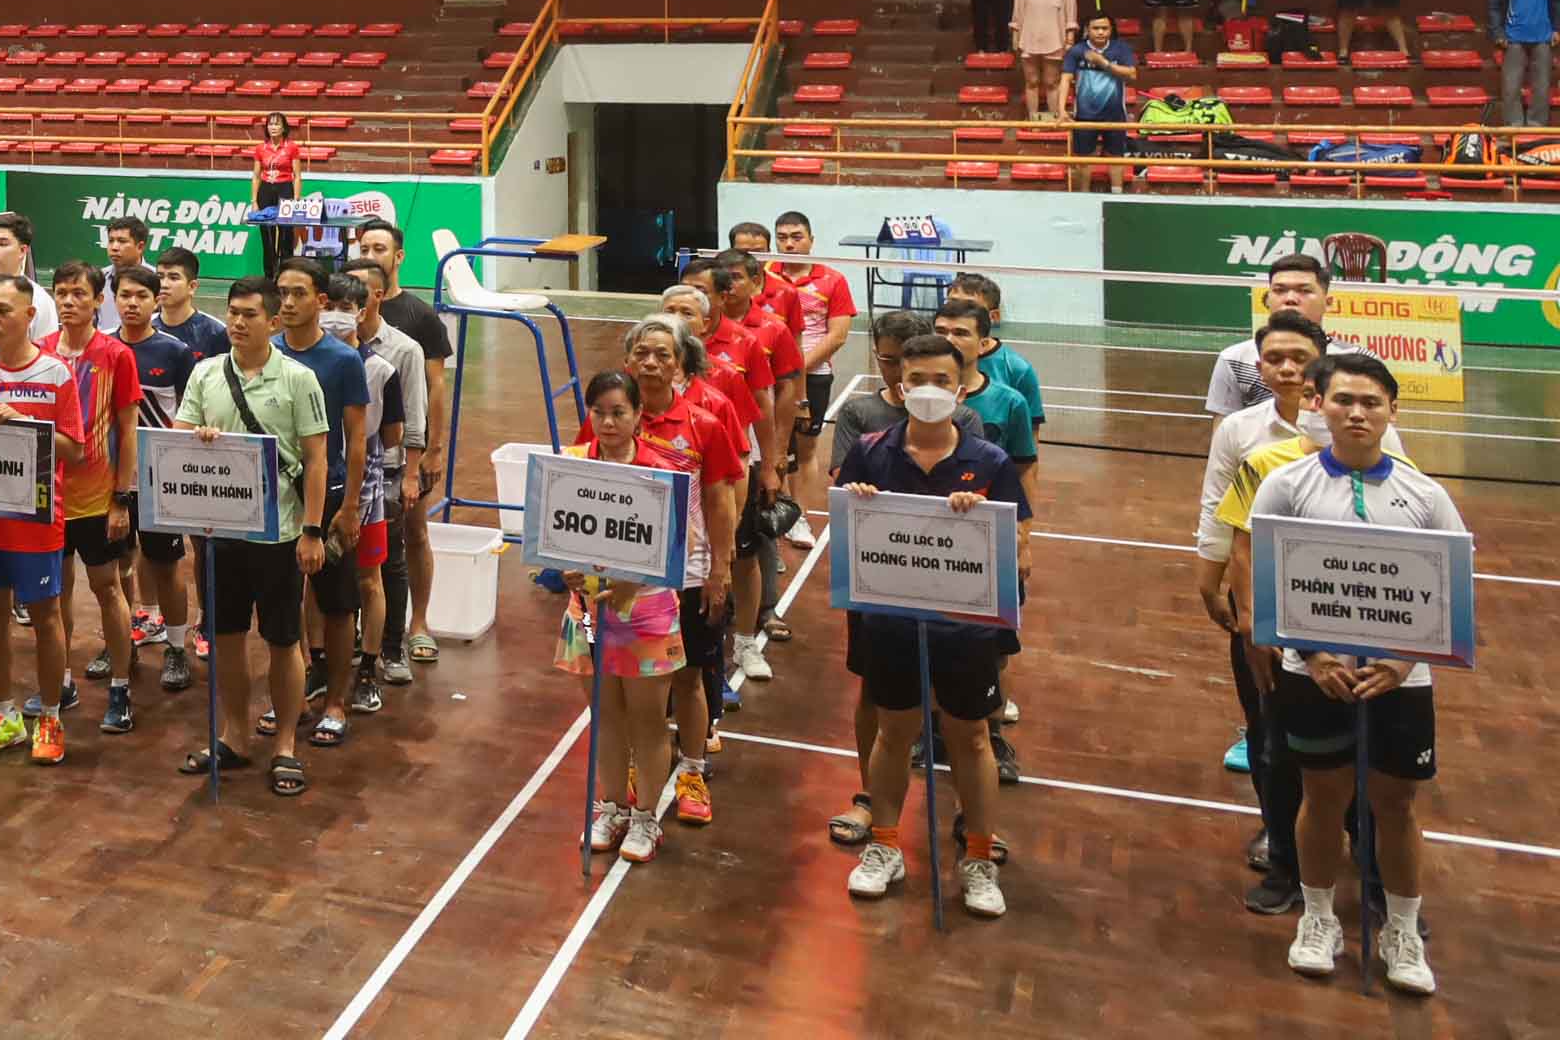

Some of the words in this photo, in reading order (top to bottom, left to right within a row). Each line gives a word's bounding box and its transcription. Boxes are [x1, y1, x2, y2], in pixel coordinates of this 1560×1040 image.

[78, 192, 169, 222] NĂNG
[1376, 234, 1536, 277] ĐỘNG
[9, 386, 48, 399] YONEX
[162, 482, 178, 495] SH
[181, 480, 209, 498] DIÊN
[211, 481, 253, 501] KHÁNH
[552, 510, 598, 536] SAO
[605, 512, 654, 545] BIỂN
[912, 555, 940, 570] HOA
[1291, 577, 1335, 595] PHÂN
[1340, 581, 1377, 601] VIỆN
[1383, 586, 1414, 603] THÚ
[1421, 591, 1432, 605] Y
[1311, 599, 1351, 619] MIỀN
[1357, 607, 1413, 625] TRUNG
